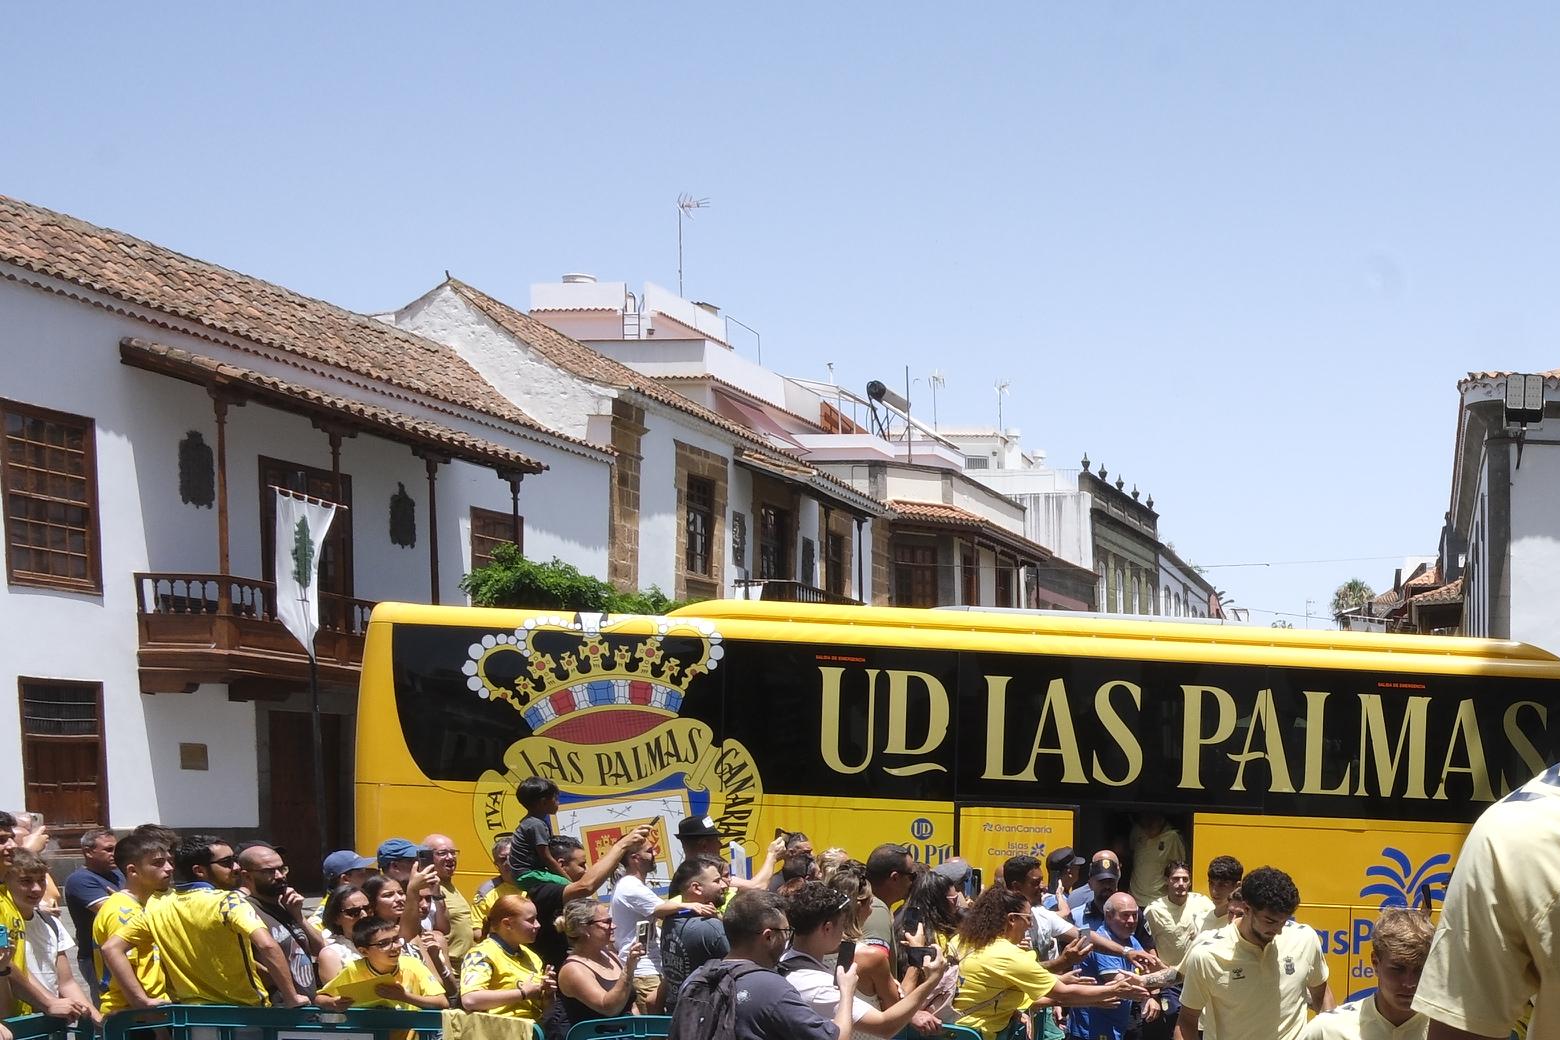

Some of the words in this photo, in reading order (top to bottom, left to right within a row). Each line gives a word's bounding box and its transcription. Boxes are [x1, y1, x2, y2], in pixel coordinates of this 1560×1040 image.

[817, 666, 950, 777] UD
[980, 675, 1144, 787] LAS
[1176, 684, 1549, 801] PALMAS
[519, 745, 585, 785] LAS
[594, 726, 702, 787] PALMAS
[913, 821, 931, 837] UD
[1007, 841, 1029, 850] Islas
[1351, 959, 1374, 978] de
